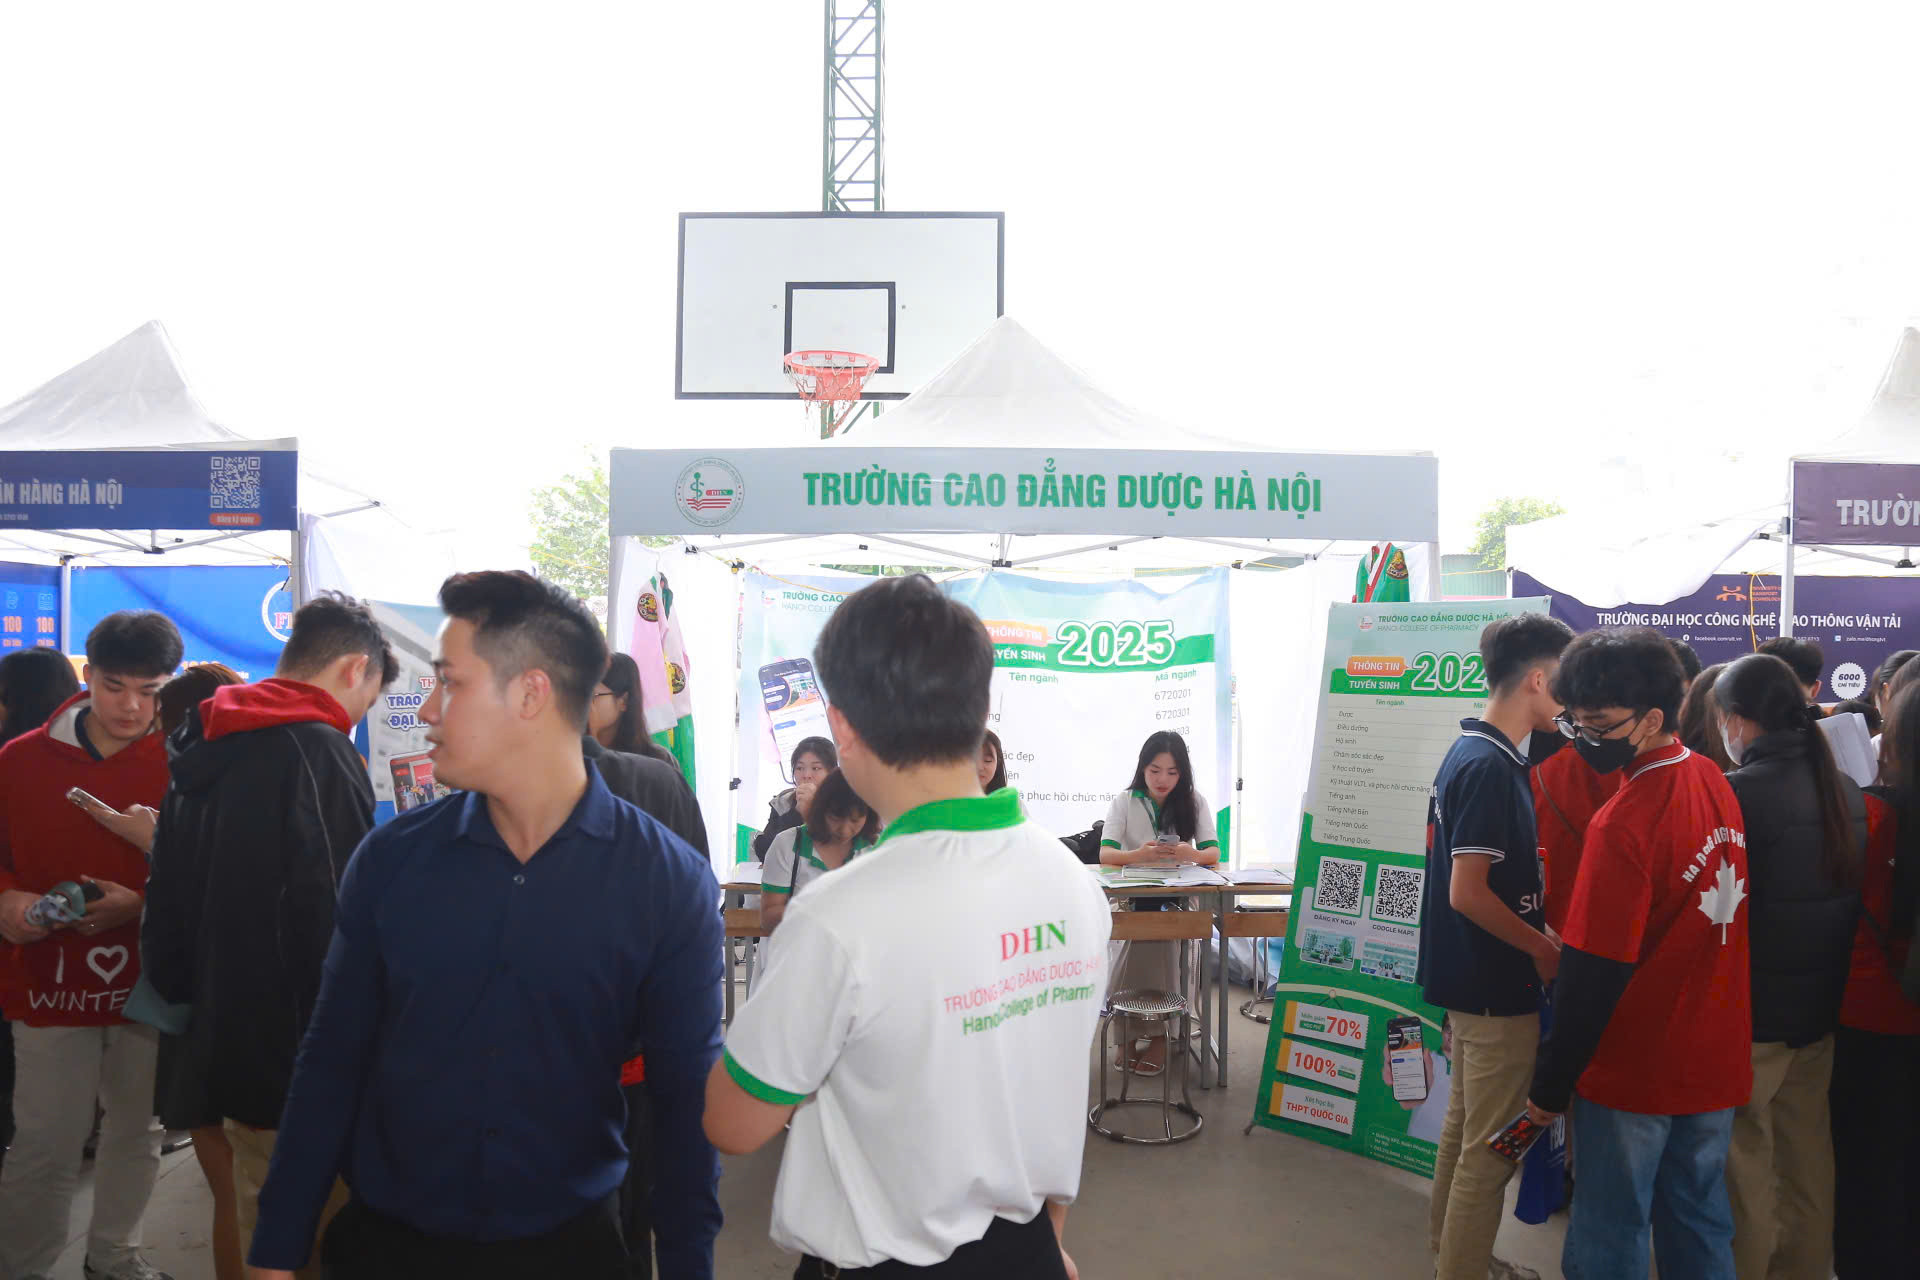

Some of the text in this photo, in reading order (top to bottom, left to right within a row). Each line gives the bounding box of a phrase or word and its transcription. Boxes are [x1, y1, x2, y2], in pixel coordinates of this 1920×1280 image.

[0, 478, 15, 505] N
[68, 478, 91, 505] HÀ
[95, 478, 123, 510] NỘI
[803, 457, 1321, 520] TRƯỜNG CAO ĐẲNG DƯỢC HÀ NỘI
[821, 594, 844, 603] CAO
[1597, 611, 1649, 626] TRƯỜNG
[1652, 612, 1672, 629] ĐẠI
[1676, 613, 1702, 629] HỌC
[1705, 611, 1740, 626] CÔNG
[1743, 611, 1776, 629] NGHỆ
[1810, 612, 1854, 627] THÔNG
[1855, 613, 1881, 631] VẬN
[1882, 612, 1901, 628] TẢI
[1025, 629, 1043, 641] TIN
[1057, 620, 1175, 666] 2025
[1020, 648, 1046, 662] SINH
[1352, 660, 1400, 671] THÔNG TIN
[1412, 652, 1488, 691] 202
[1009, 672, 1059, 685] Tên ngành
[1171, 669, 1197, 680] ngành
[1838, 673, 1861, 681] 6000
[1349, 678, 1400, 690] TUYỂN SINH
[388, 695, 421, 706] TRAO
[1154, 688, 1192, 701] 6720201
[1155, 708, 1190, 720] 6720301
[390, 714, 414, 729] ĐẠI
[1016, 751, 1035, 763] đẹp
[1340, 919, 1357, 927] NGAY
[1372, 924, 1415, 937] GOOGLE MAPS
[999, 920, 1067, 962] DHN
[56, 946, 64, 984] I
[28, 988, 130, 1012] WINTE
[1037, 988, 1049, 1009] of
[1052, 984, 1096, 1006] Pharm
[1326, 1015, 1362, 1040] 70%
[1294, 1052, 1337, 1077] 100%
[1286, 1101, 1349, 1126] THPT QUỐC GIA
